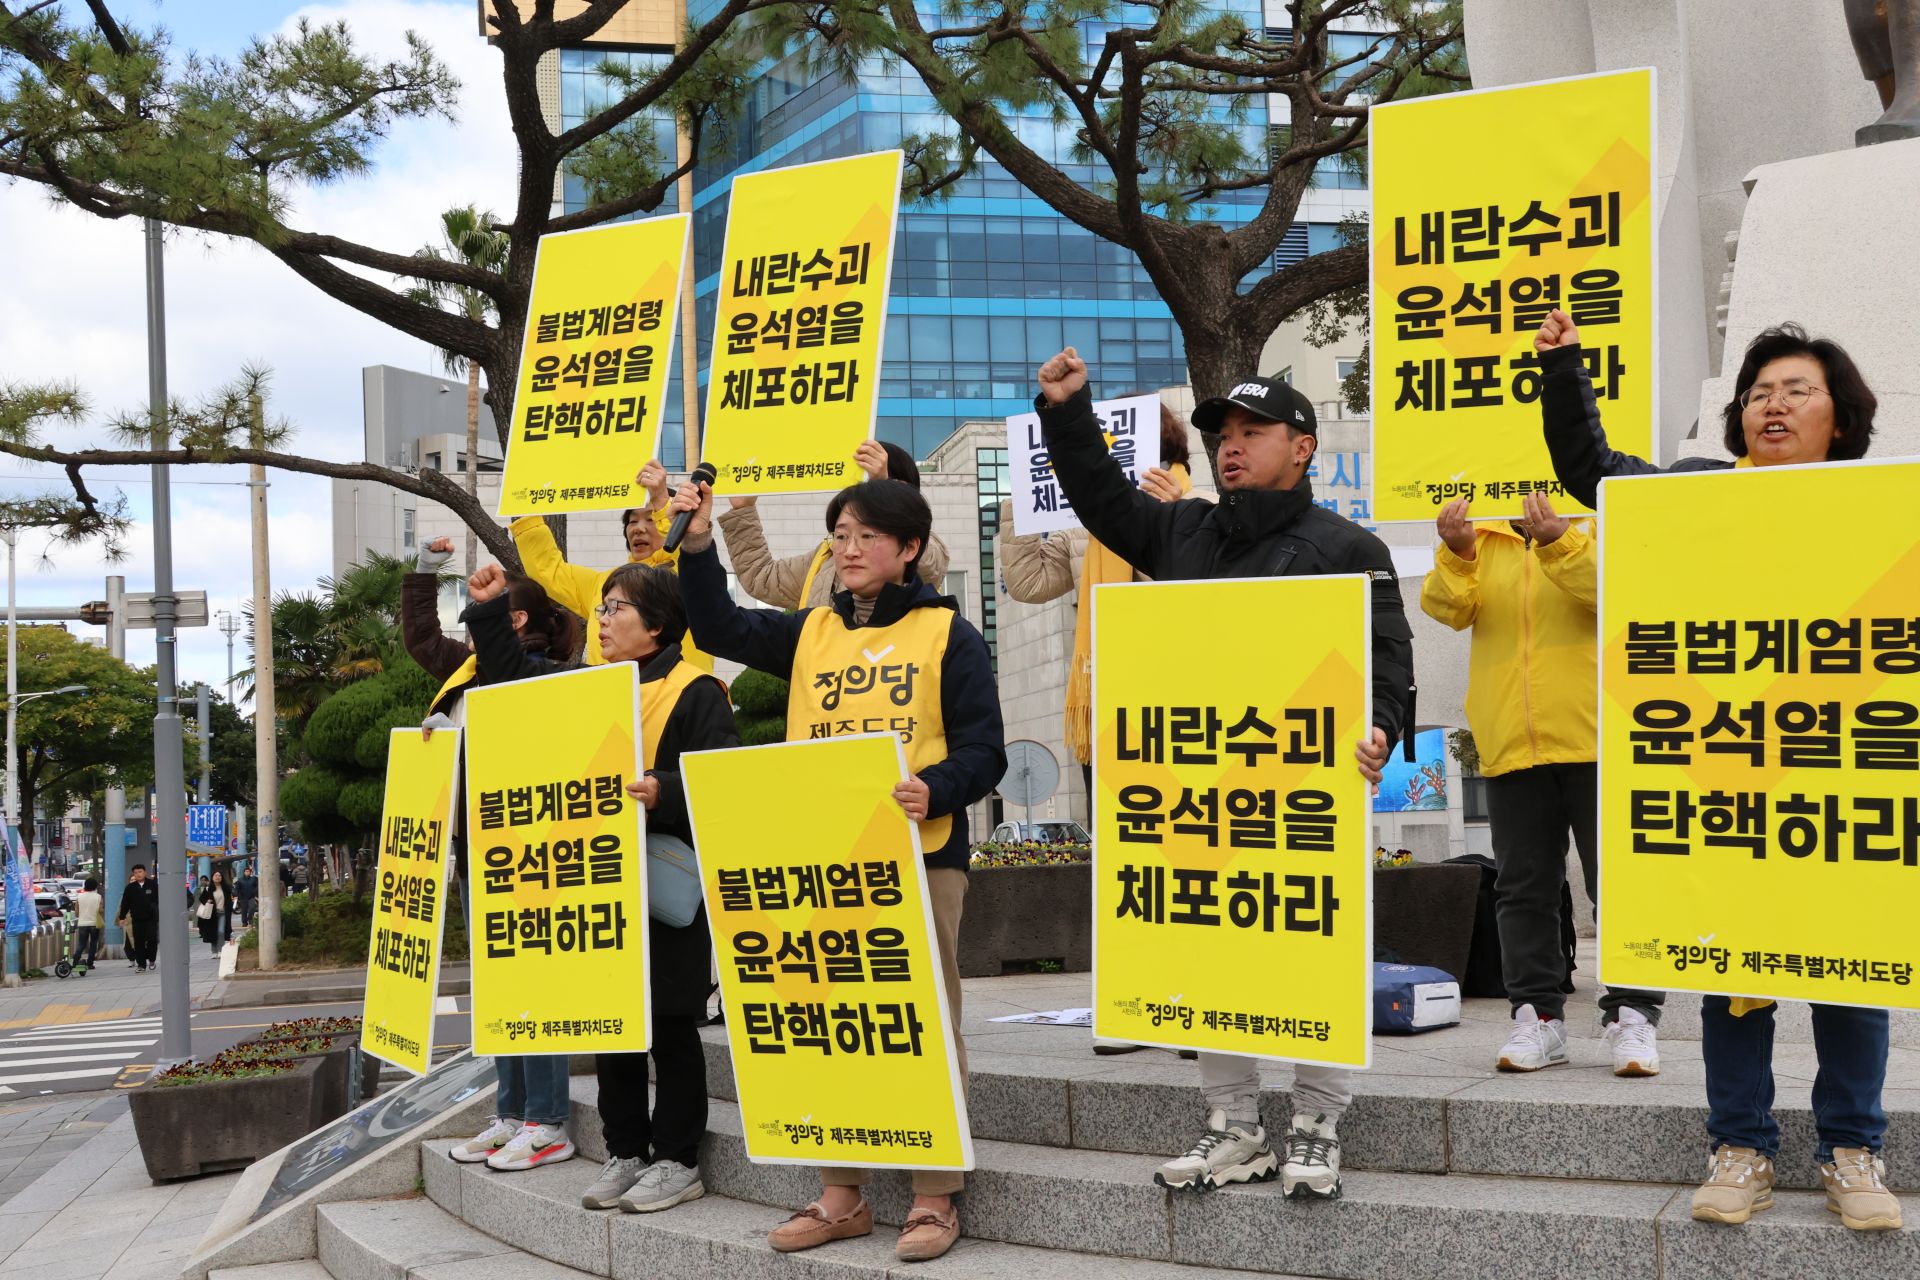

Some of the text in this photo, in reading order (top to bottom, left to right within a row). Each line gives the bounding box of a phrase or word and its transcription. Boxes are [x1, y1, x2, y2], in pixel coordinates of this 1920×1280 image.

[1395, 192, 1619, 266] 내란수괴
[733, 243, 870, 297] 내란수괴
[537, 300, 663, 343] 불법계엄령
[728, 301, 863, 355] 윤석열을
[1395, 269, 1622, 341] 윤석열을
[532, 345, 653, 392] 윤석열을
[721, 360, 859, 409] 체포하라
[524, 396, 647, 441] 탄핵하라
[530, 489, 556, 504] 정의당
[560, 485, 629, 500] 제주특별자치도당
[733, 466, 762, 482] 정의당
[767, 462, 844, 478] 제주특별자치도당
[1425, 482, 1476, 505] 정의당
[1625, 617, 1920, 674] 불법계엄령
[813, 662, 919, 711] 정의당
[1117, 706, 1334, 767] 내란수괴
[1630, 700, 1920, 770] 윤석열을
[479, 774, 623, 830] 불법계엄령
[1117, 785, 1337, 852] 윤석열을
[385, 816, 441, 863] 내란수괴
[484, 835, 622, 894] 윤석열을
[380, 871, 435, 922] 윤석열을
[718, 861, 902, 911] 불법계엄령
[1117, 865, 1339, 936] 체포하라
[374, 928, 430, 982] 체포하라
[486, 901, 626, 958] 탄핵하라
[733, 928, 911, 983] 윤석열을
[1667, 945, 1913, 985] 정의당 제주특별자치도당
[506, 1021, 536, 1040] 정의당
[542, 1019, 623, 1036] 제주특별자치도당
[743, 1002, 923, 1056] 탄핵하라
[1146, 1003, 1330, 1041] 정의당 제주특별자치도당
[784, 1125, 932, 1148] 정의당 제주특별자치도당
